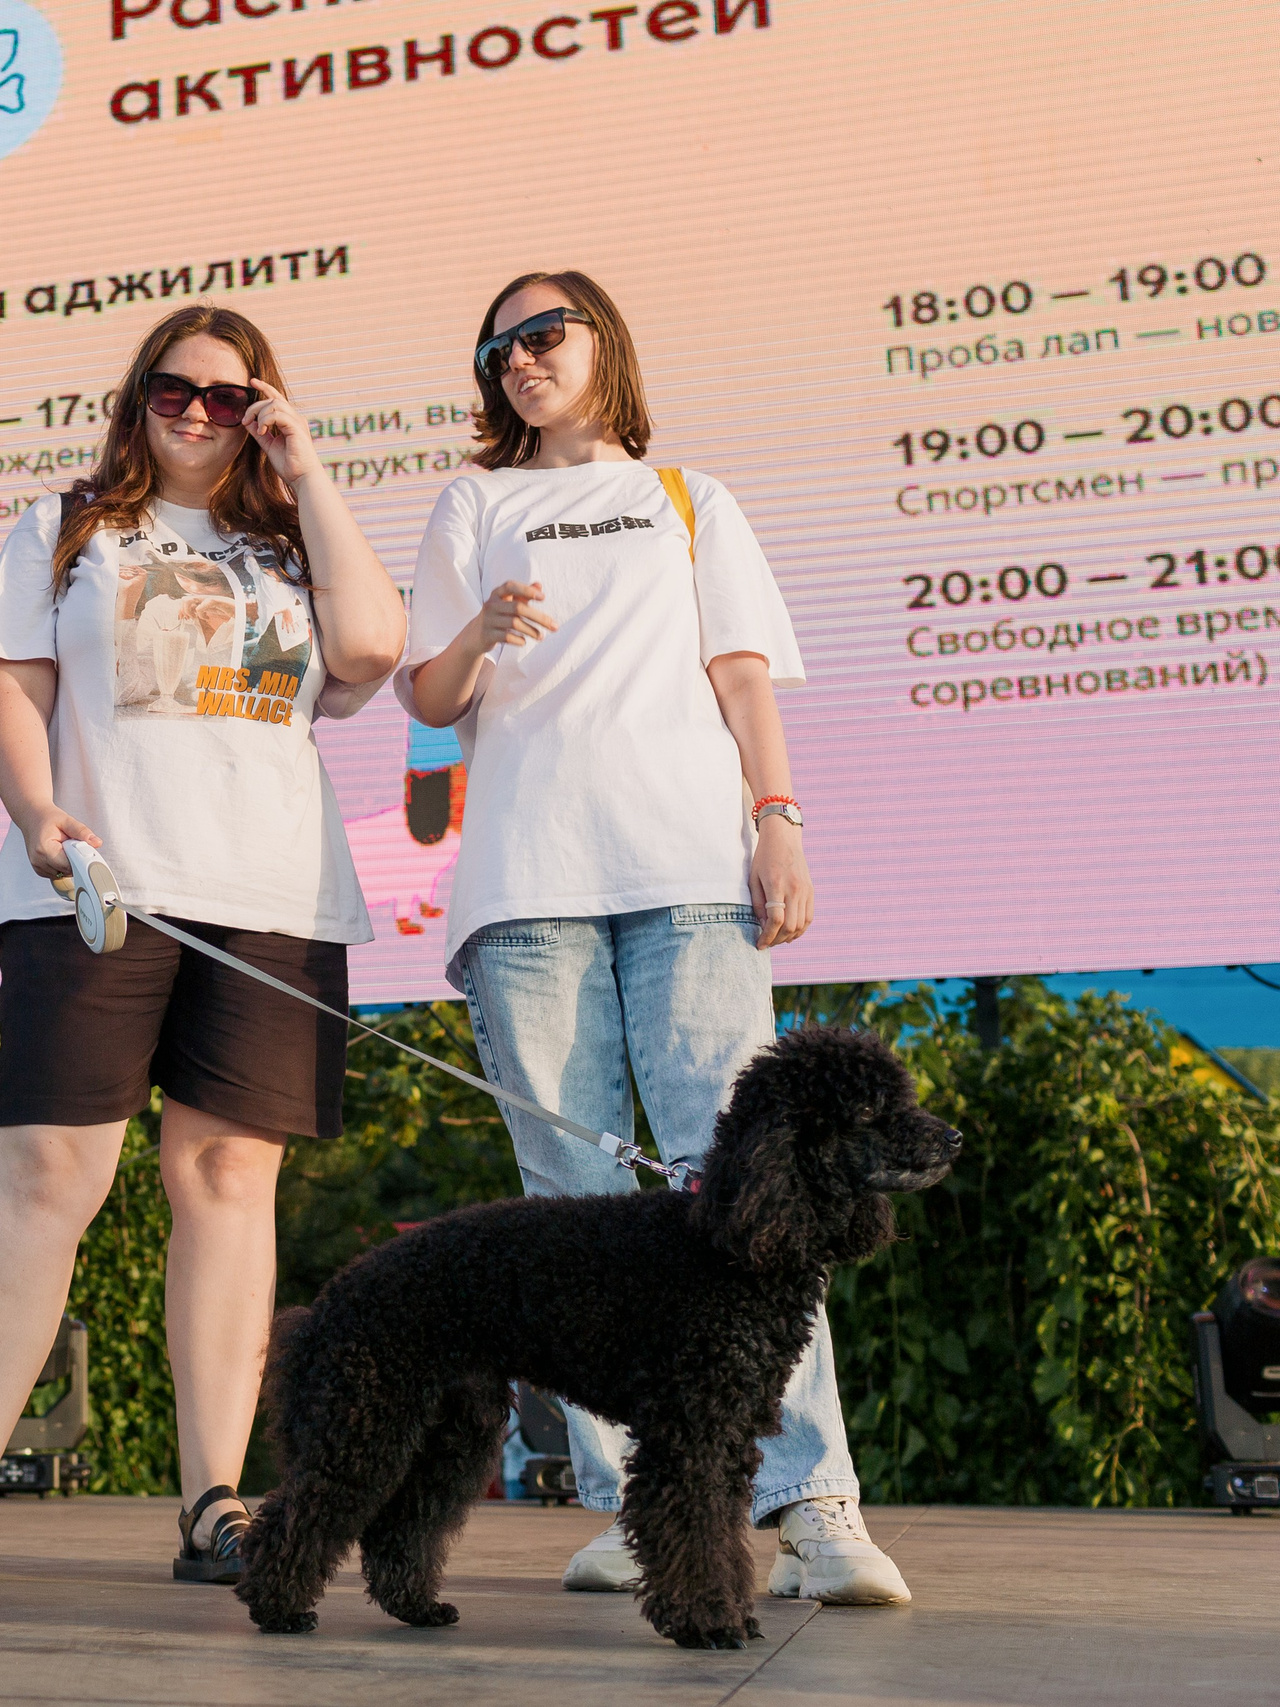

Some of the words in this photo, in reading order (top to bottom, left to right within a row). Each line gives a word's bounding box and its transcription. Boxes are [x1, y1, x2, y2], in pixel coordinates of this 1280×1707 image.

[23, 243, 351, 317] аджилити
[882, 280, 1034, 328] 18:00
[1109, 252, 1267, 302] 19:00
[885, 335, 1025, 378] Проба
[1040, 327, 1120, 359] лап
[1196, 310, 1280, 340] нов
[893, 419, 1046, 467] 19:00
[1121, 394, 1280, 444] 20:00
[895, 471, 1145, 516] Спортсмен
[902, 562, 1069, 609] 20:00
[1145, 543, 1280, 589] 21:0
[906, 614, 1161, 658] Свободное
[196, 665, 252, 694] MRS.
[257, 669, 299, 700] MIA
[196, 691, 294, 727] WALLACE
[909, 650, 1269, 712] соревнований)
